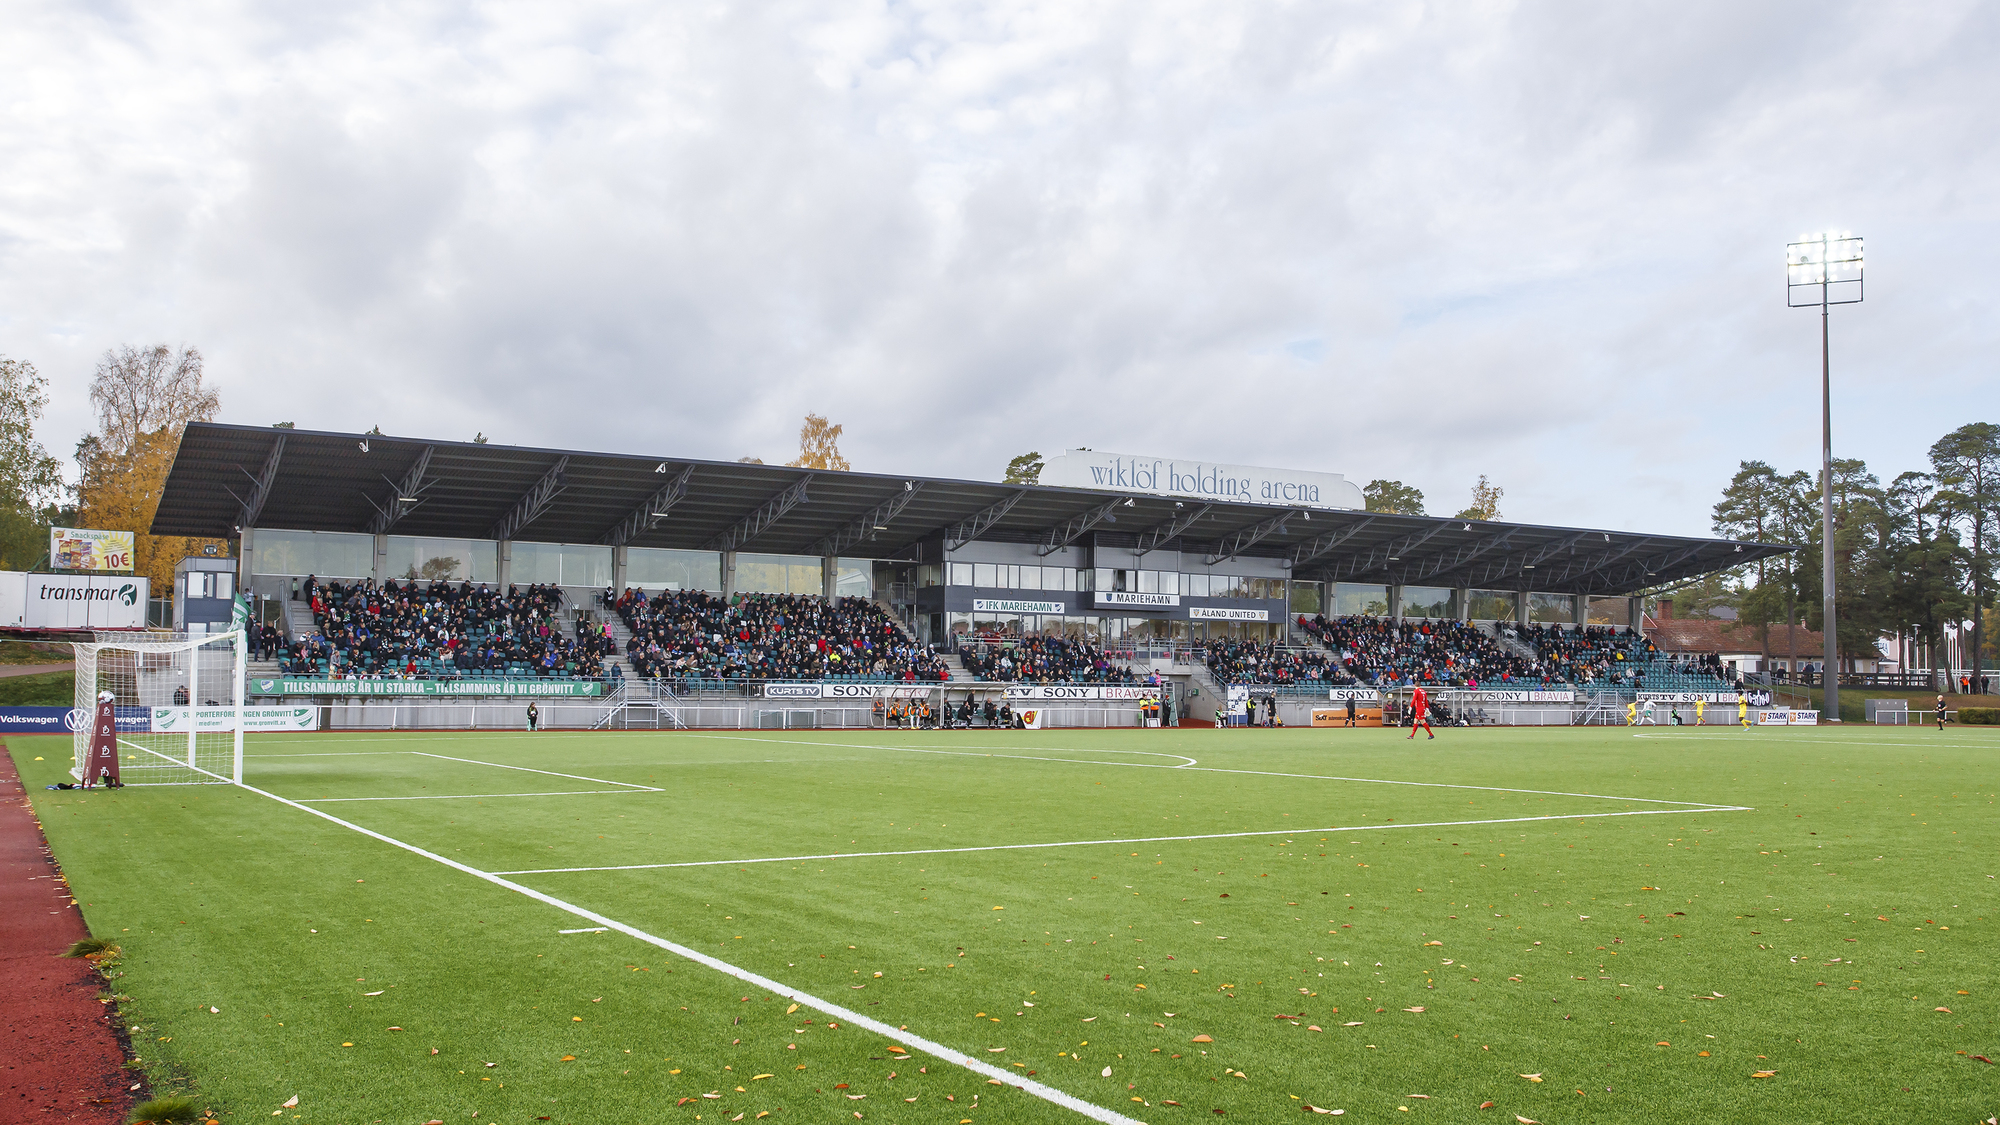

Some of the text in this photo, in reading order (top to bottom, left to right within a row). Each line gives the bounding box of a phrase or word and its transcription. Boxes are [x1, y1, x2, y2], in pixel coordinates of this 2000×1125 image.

[1089, 457, 1320, 502] wiklöf holding arena
[103, 552, 130, 569] 10€
[40, 583, 119, 602] transmar
[1116, 593, 1171, 605] MARIEHAMN
[985, 600, 1053, 612] IFK MARIEHAMN
[1229, 610, 1257, 619] UNITED
[283, 682, 355, 694] TILLSAMMANS
[357, 680, 372, 693] ÄR
[374, 682, 384, 693] VI
[386, 682, 424, 694] STARKA
[434, 683, 500, 694] TILLSAMMANS
[502, 681, 515, 694] ÄR
[517, 683, 527, 694] VI
[529, 681, 574, 694] GRÖNVITT
[770, 687, 818, 695] KURTS TV
[833, 685, 882, 697] SONY
[1006, 688, 1032, 696] TV
[1043, 687, 1090, 698] SONY
[1336, 690, 1374, 700] SONY
[1488, 692, 1521, 700] SONY
[1534, 692, 1569, 701] BRAVIA
[261, 709, 292, 718] GRÖNVITT
[1767, 712, 1788, 720] STARK
[1797, 712, 1817, 720] STARK
[0, 715, 59, 725] Volkswagen
